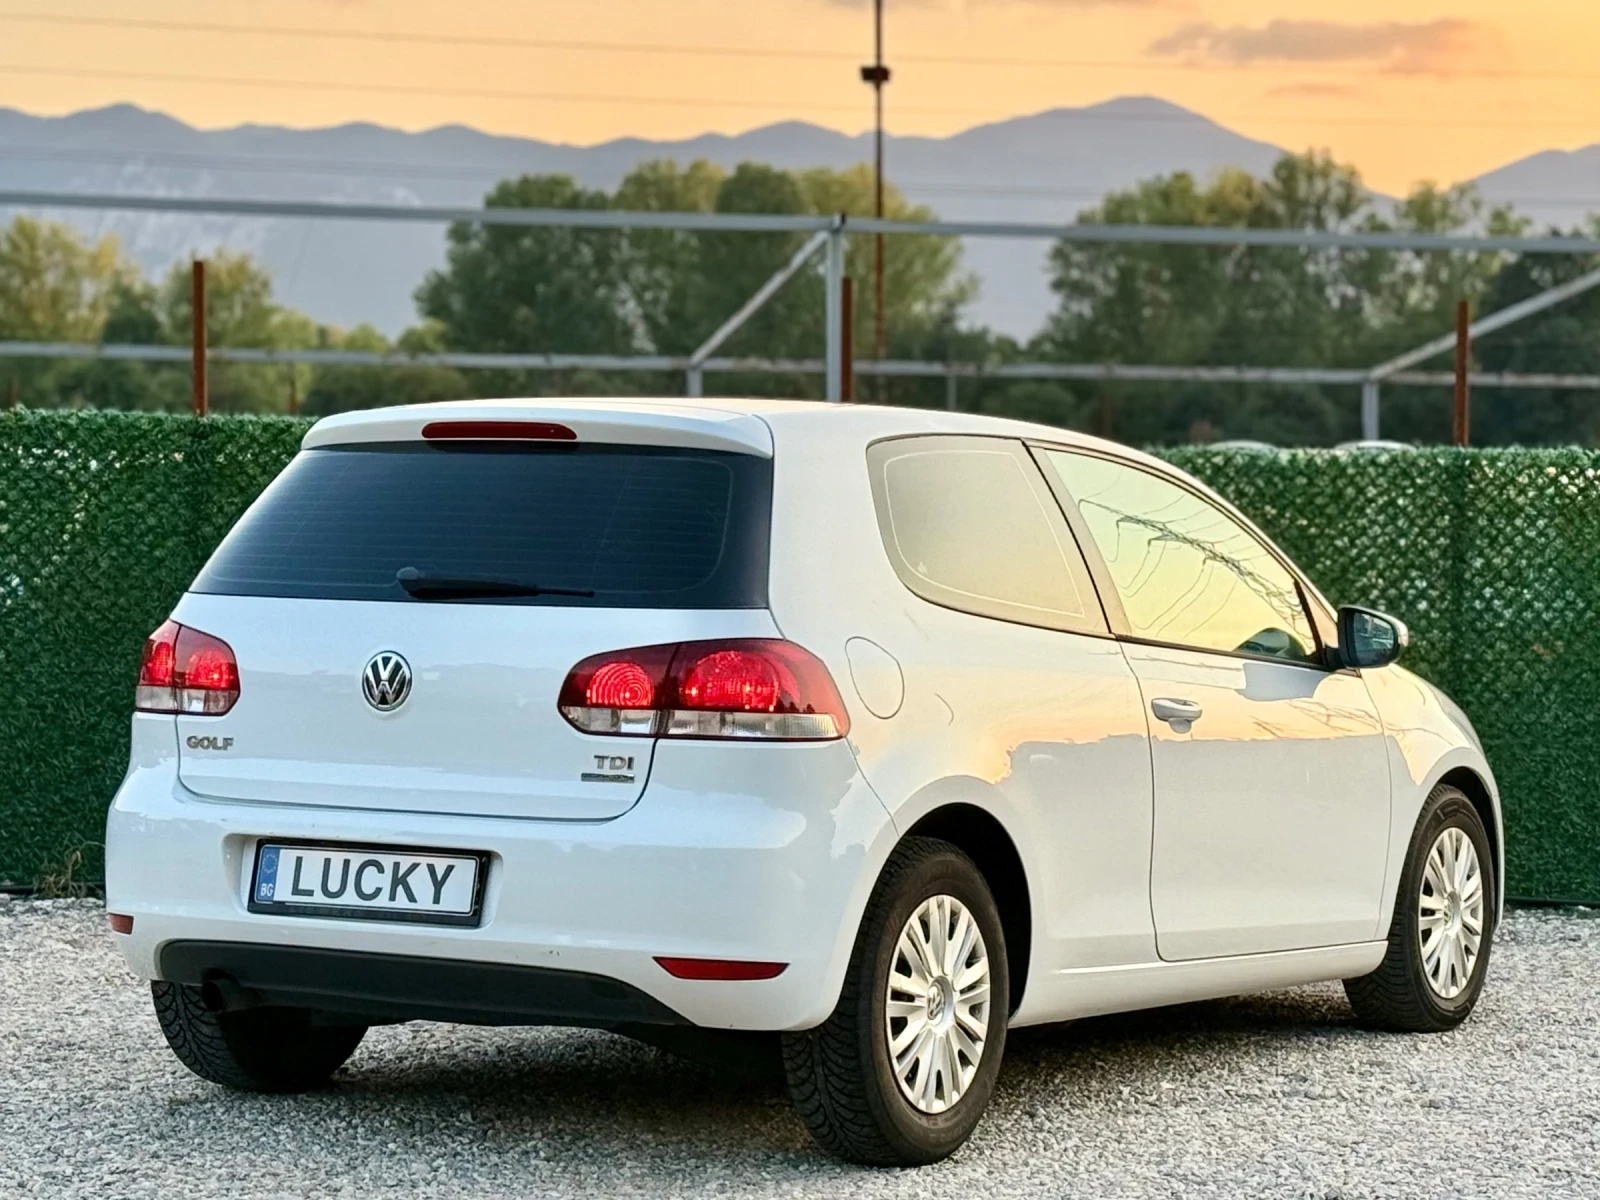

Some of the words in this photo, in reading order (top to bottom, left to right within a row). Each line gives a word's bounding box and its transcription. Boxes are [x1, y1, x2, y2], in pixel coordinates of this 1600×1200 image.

[363, 652, 409, 709] VW
[186, 735, 234, 751] GOLF
[593, 754, 635, 771] TDI
[290, 856, 456, 906] LUCKY
[260, 883, 275, 897] BG
